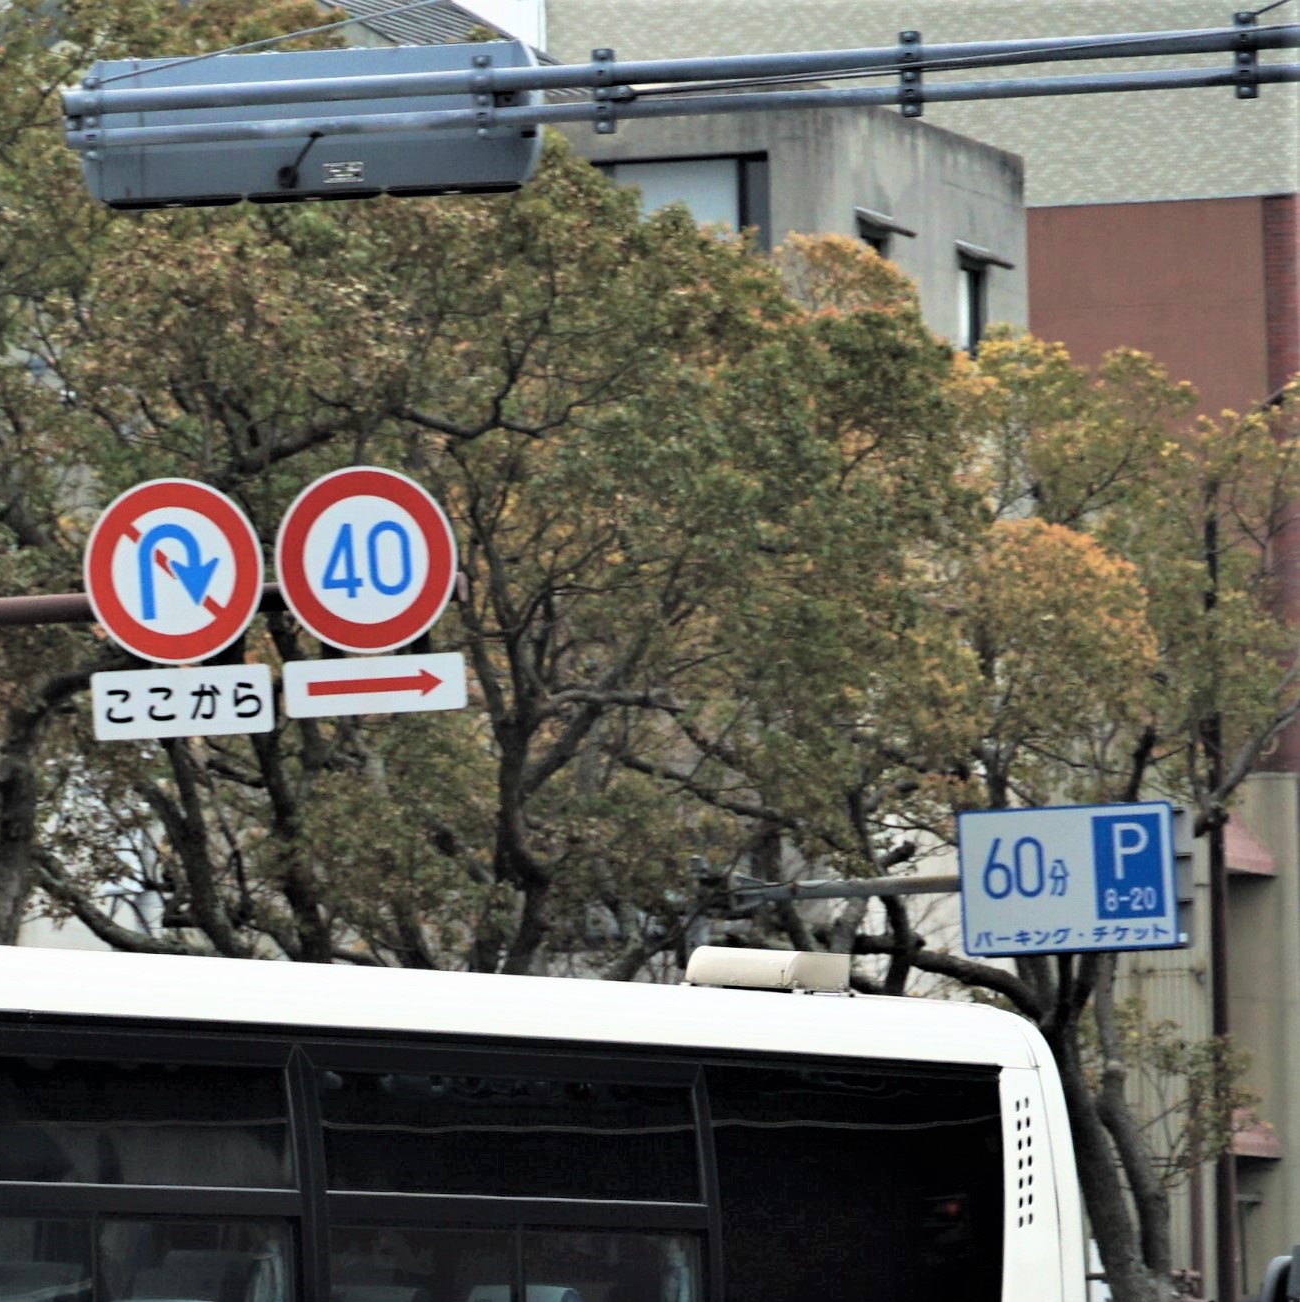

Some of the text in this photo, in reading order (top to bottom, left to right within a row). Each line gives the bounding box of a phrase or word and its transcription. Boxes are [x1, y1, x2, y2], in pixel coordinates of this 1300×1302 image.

[322, 520, 413, 599] 40
[105, 682, 263, 723] ここから
[982, 836, 1070, 900] 60分
[1112, 822, 1150, 881] P
[1104, 887, 1157, 912] 8-20
[974, 923, 1170, 948] パーキング・チケット
